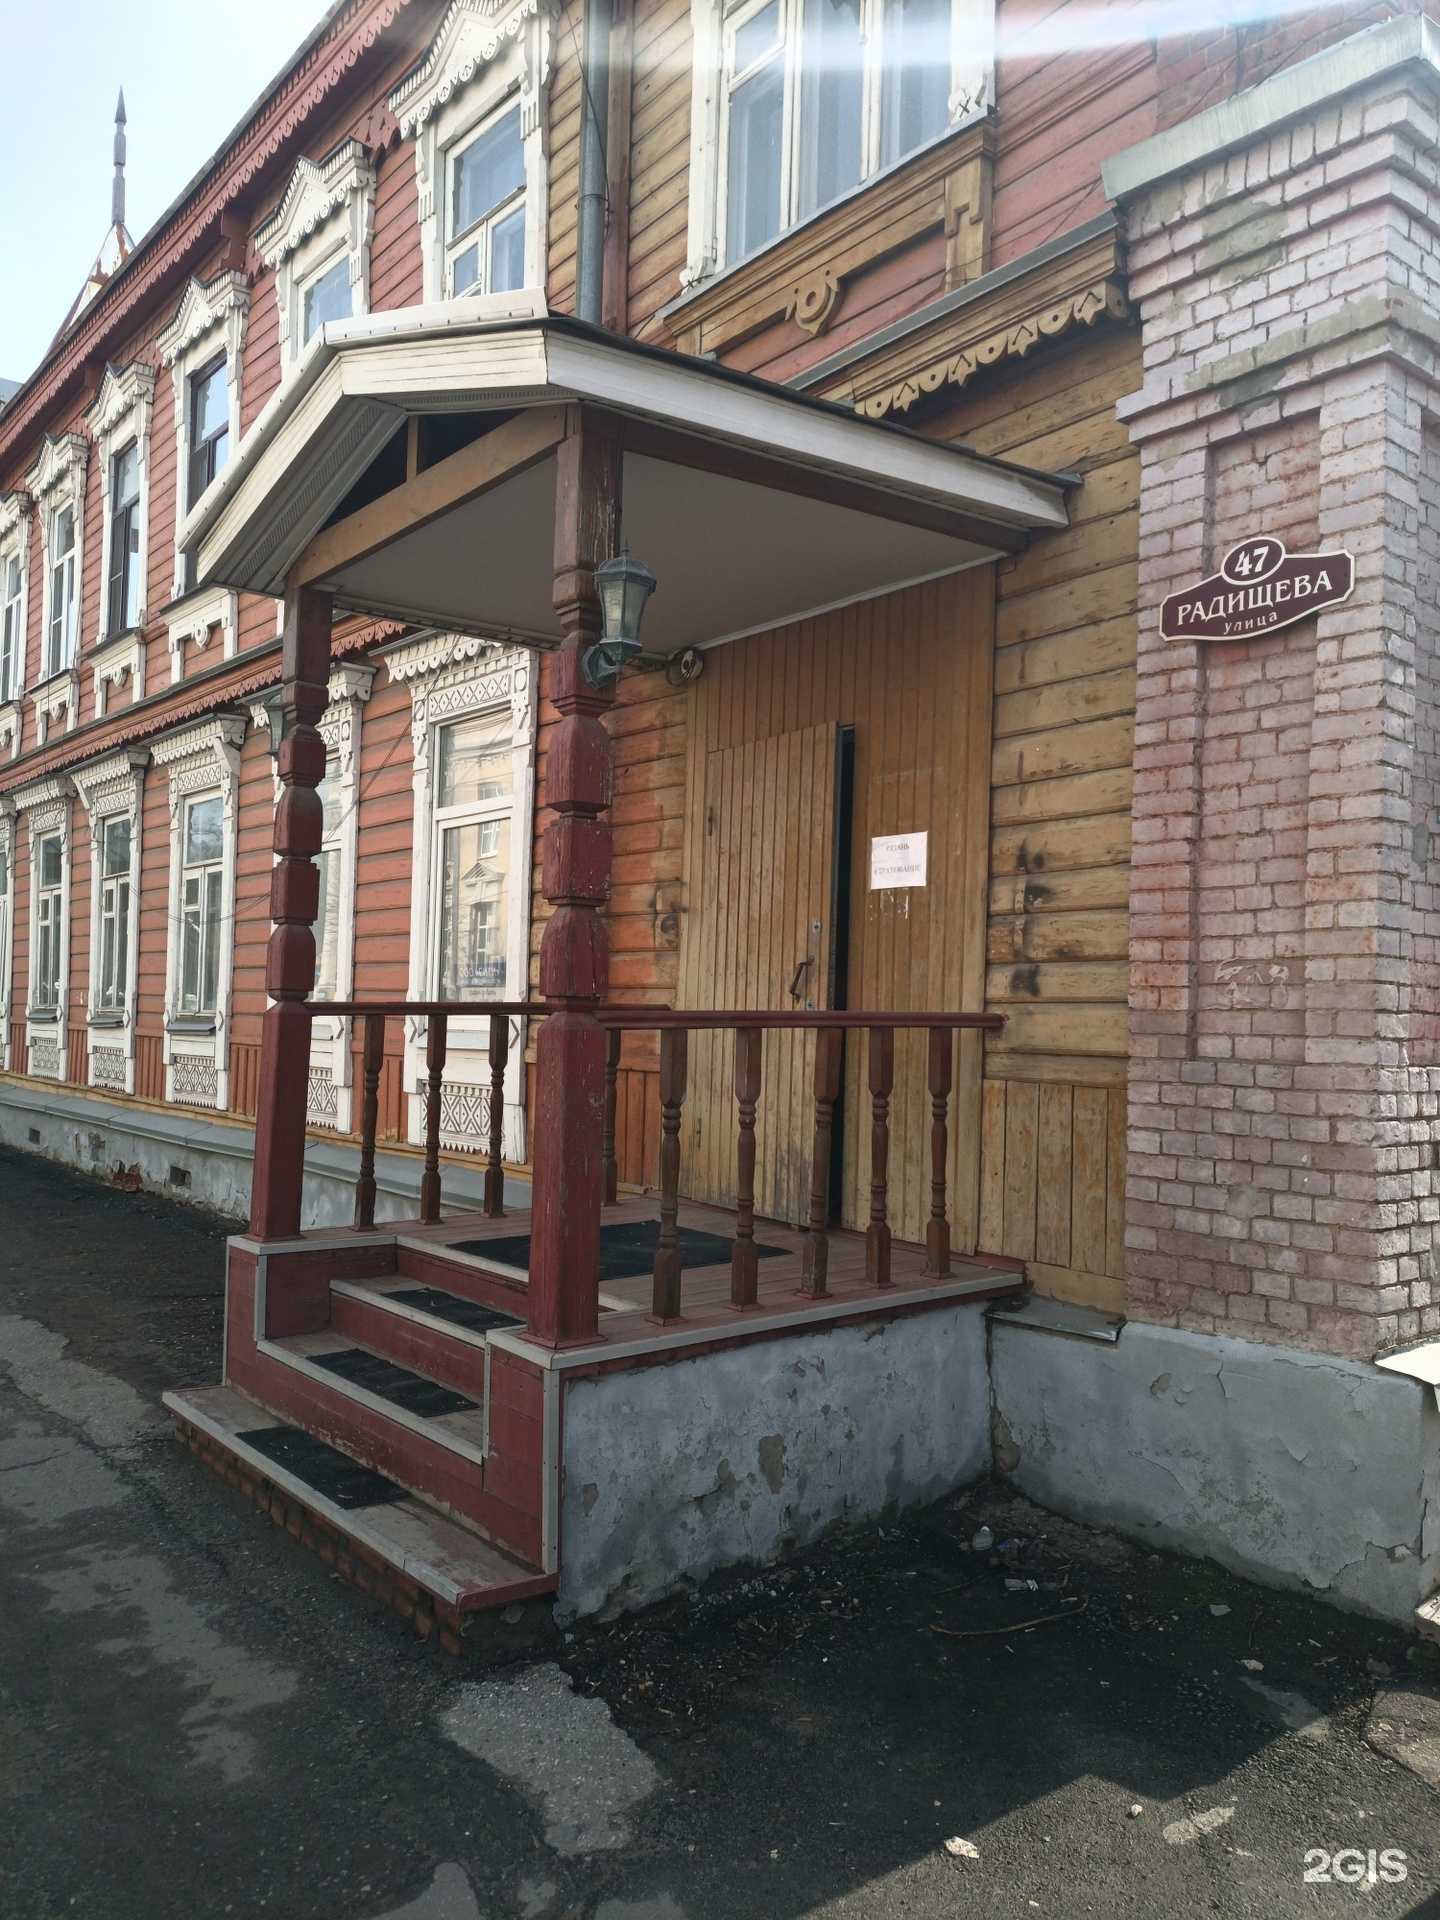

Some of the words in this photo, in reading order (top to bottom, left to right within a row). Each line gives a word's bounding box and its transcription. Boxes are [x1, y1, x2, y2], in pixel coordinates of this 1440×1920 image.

[1234, 546, 1270, 576] 47
[1177, 570, 1333, 626] РАДИЩЕВА
[1223, 611, 1278, 635] улица
